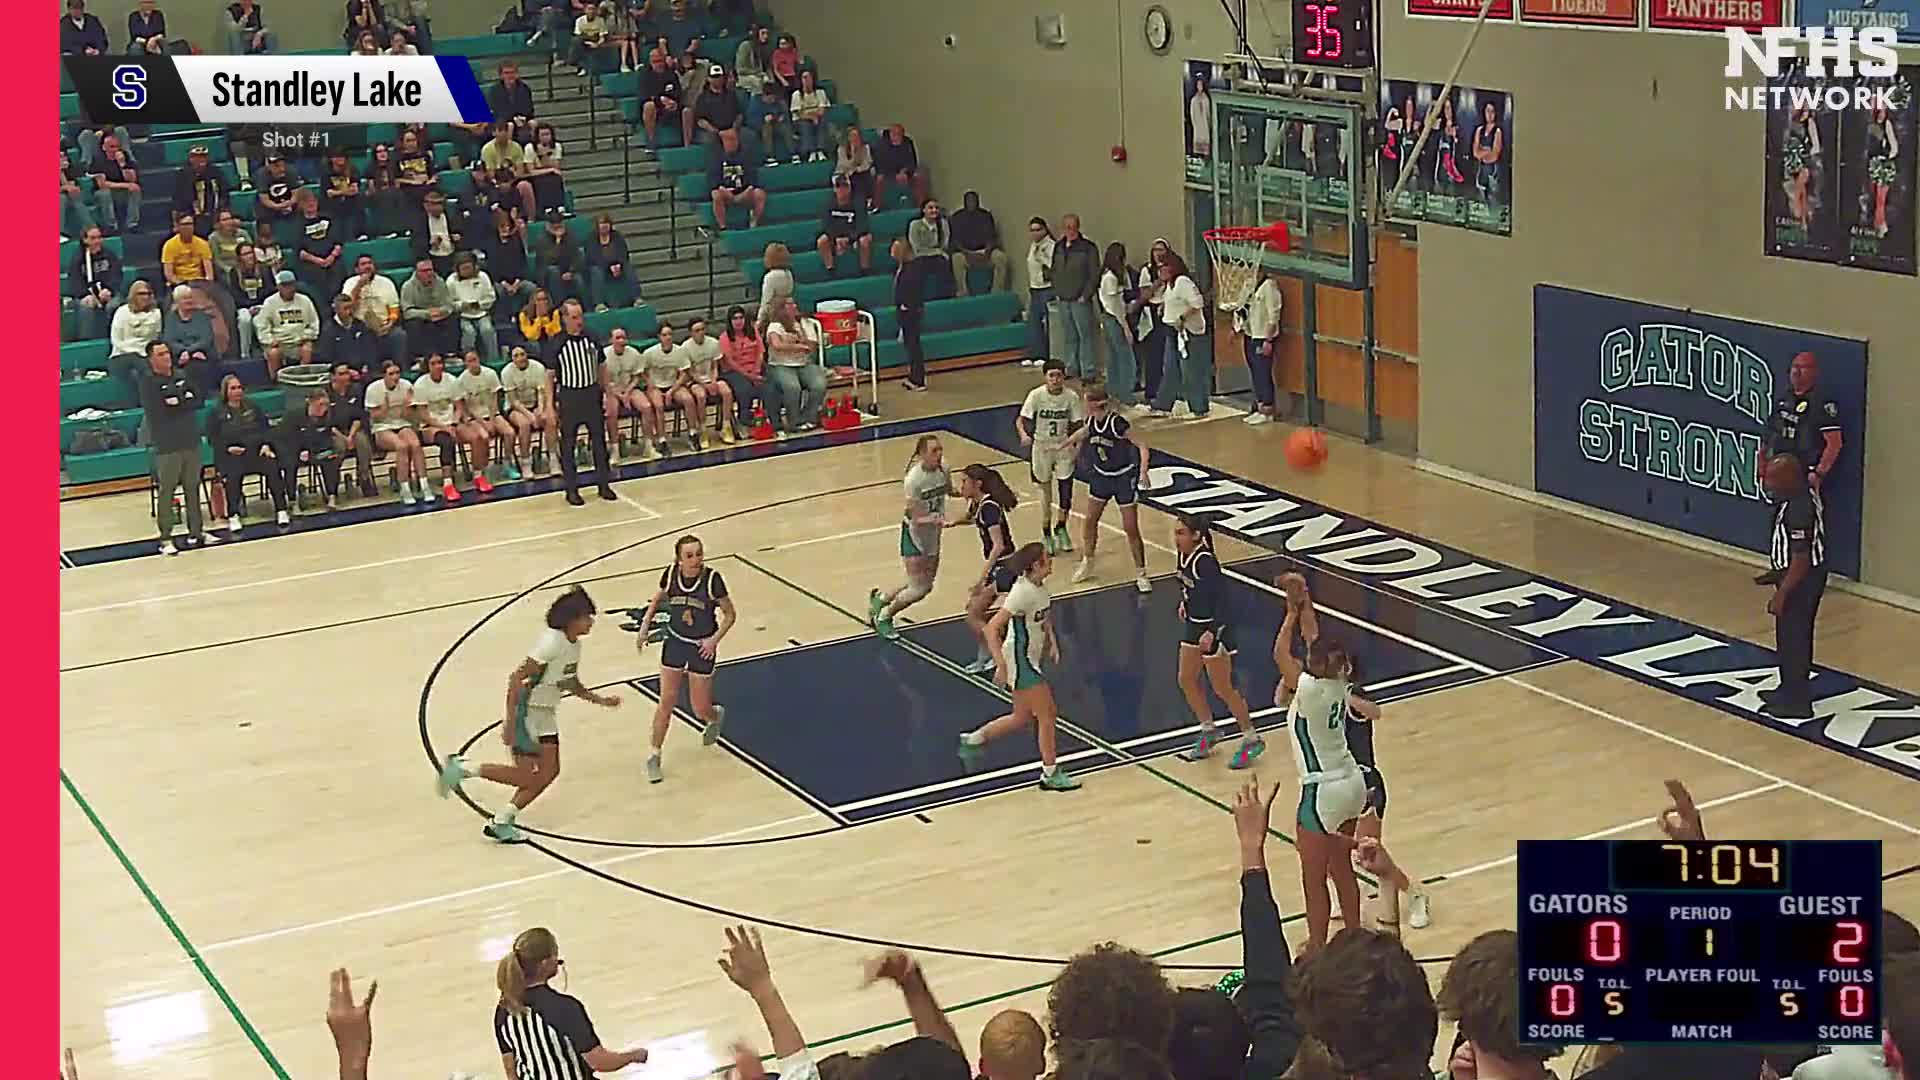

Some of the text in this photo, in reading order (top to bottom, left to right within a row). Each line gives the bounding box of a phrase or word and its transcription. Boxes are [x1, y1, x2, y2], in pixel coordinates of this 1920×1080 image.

[1305, 4, 1341, 57] 35
[1667, 0, 1763, 21] PANTHERS
[1600, 324, 1773, 425] GATOR
[1579, 398, 1773, 504] STRON
[1138, 465, 1655, 637] STANDLEY
